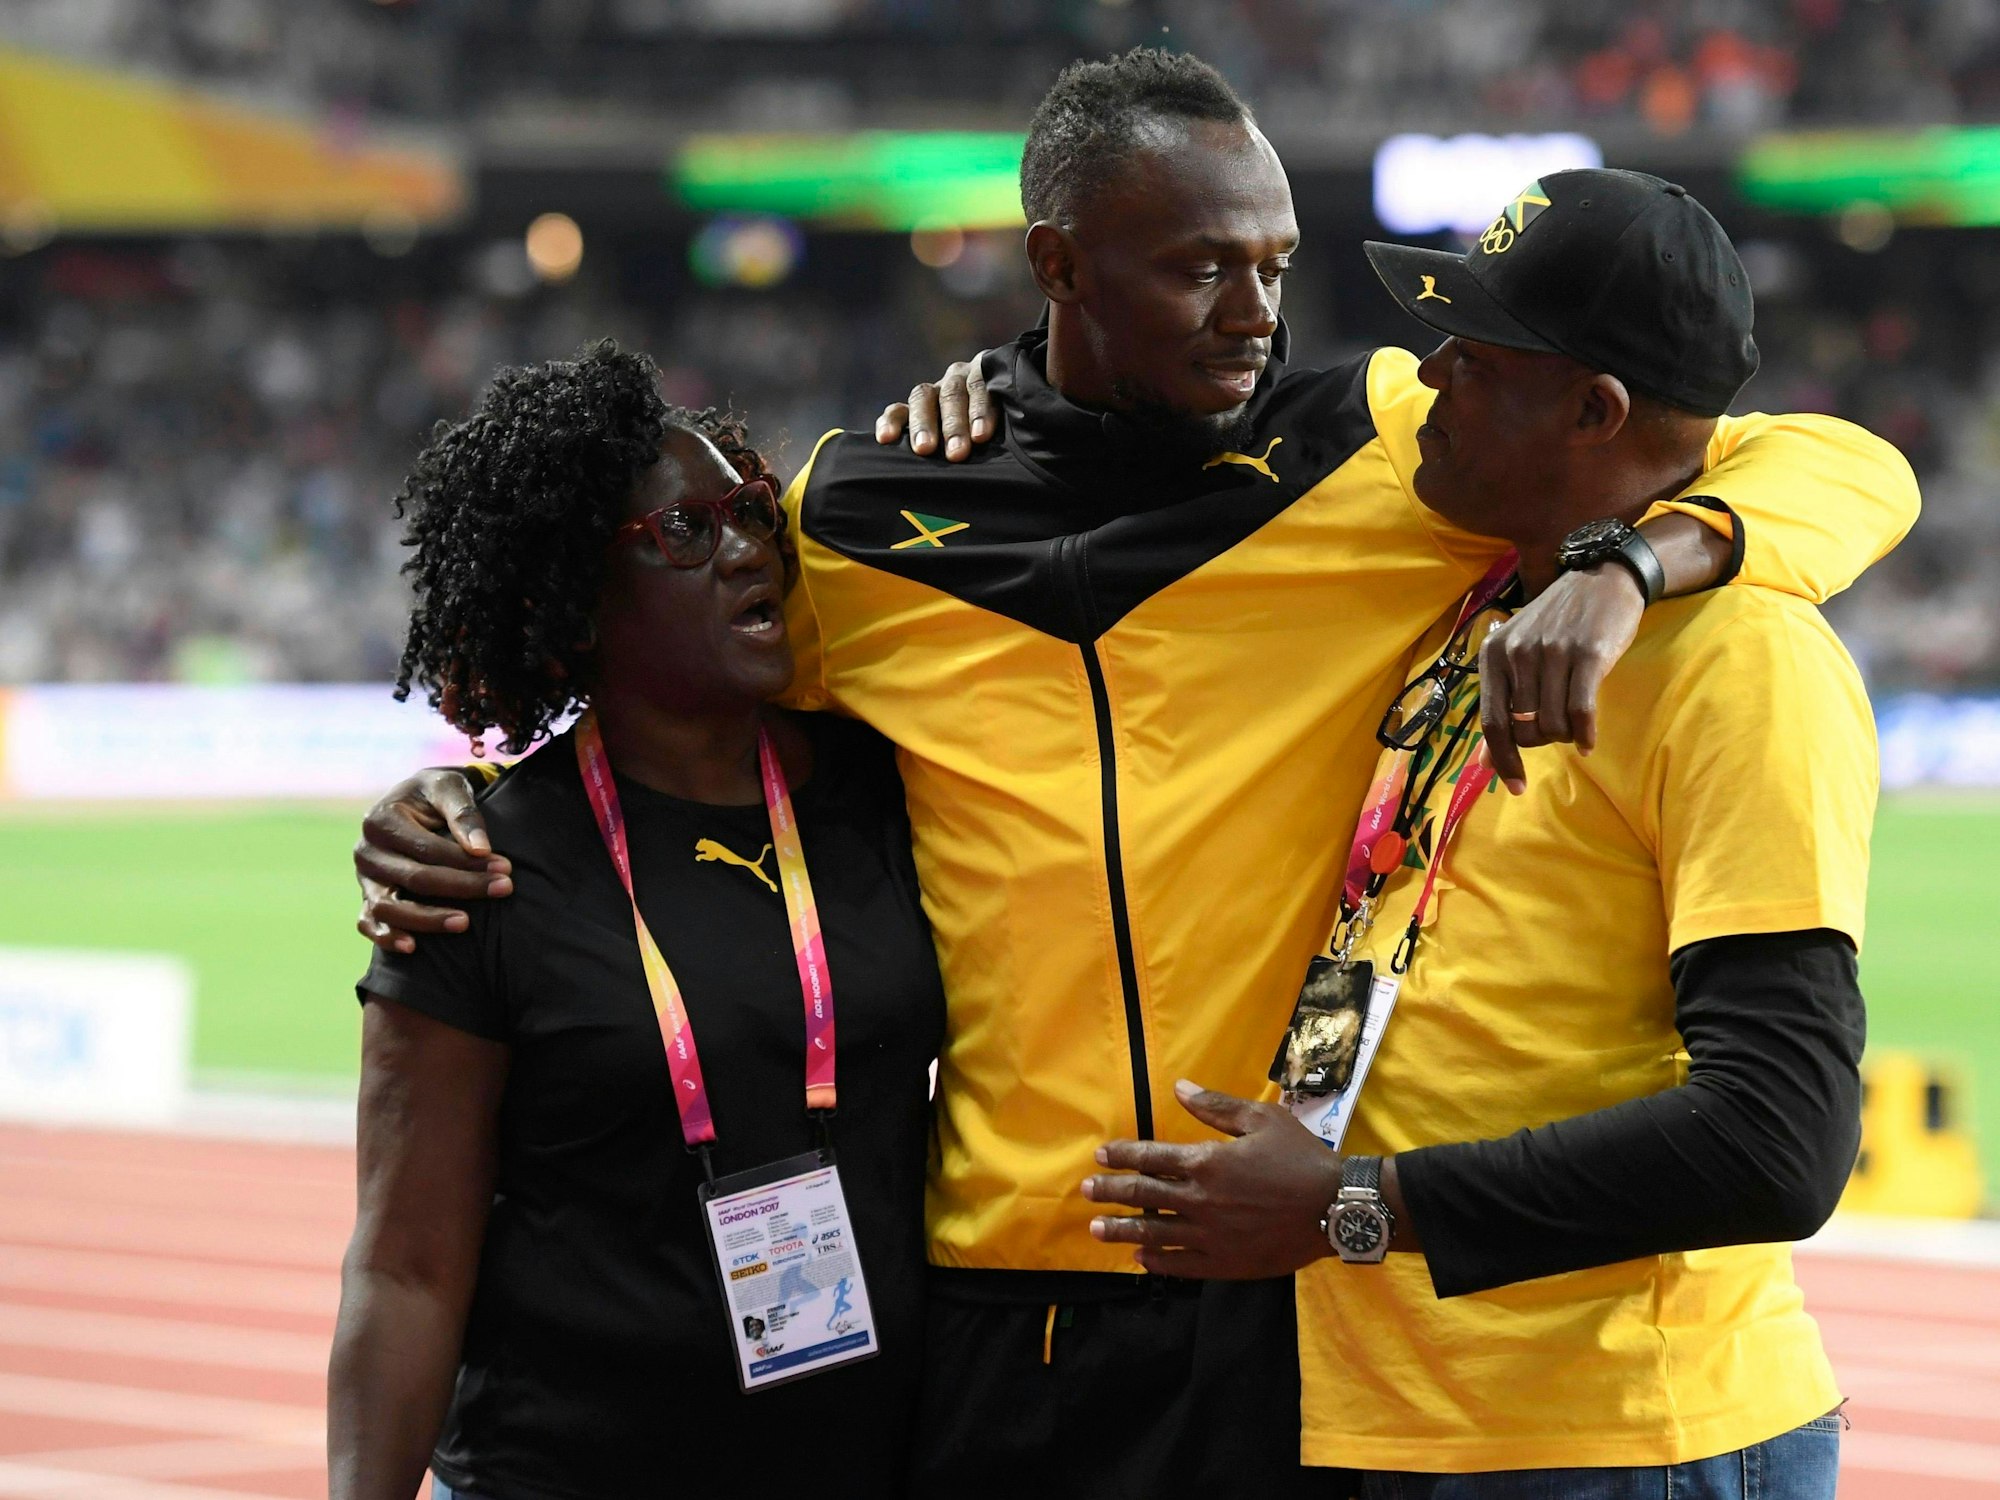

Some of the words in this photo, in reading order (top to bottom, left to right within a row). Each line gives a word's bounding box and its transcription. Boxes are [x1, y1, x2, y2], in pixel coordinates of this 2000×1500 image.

[1370, 804, 1383, 830] IAAF
[1379, 783, 1392, 806] World
[1451, 782, 1473, 817] LONDON
[809, 963, 821, 998] LONDON
[814, 998, 823, 1019] 2017
[675, 1035, 688, 1060] IAAF
[719, 1208, 759, 1226] LONDON
[760, 1202, 780, 1215] 2017
[820, 1229, 841, 1241] asics
[739, 1252, 760, 1263] TDK
[769, 1240, 805, 1256] TOYOTA
[730, 1262, 768, 1281] SEIKO
[765, 1343, 785, 1356] IAAF
